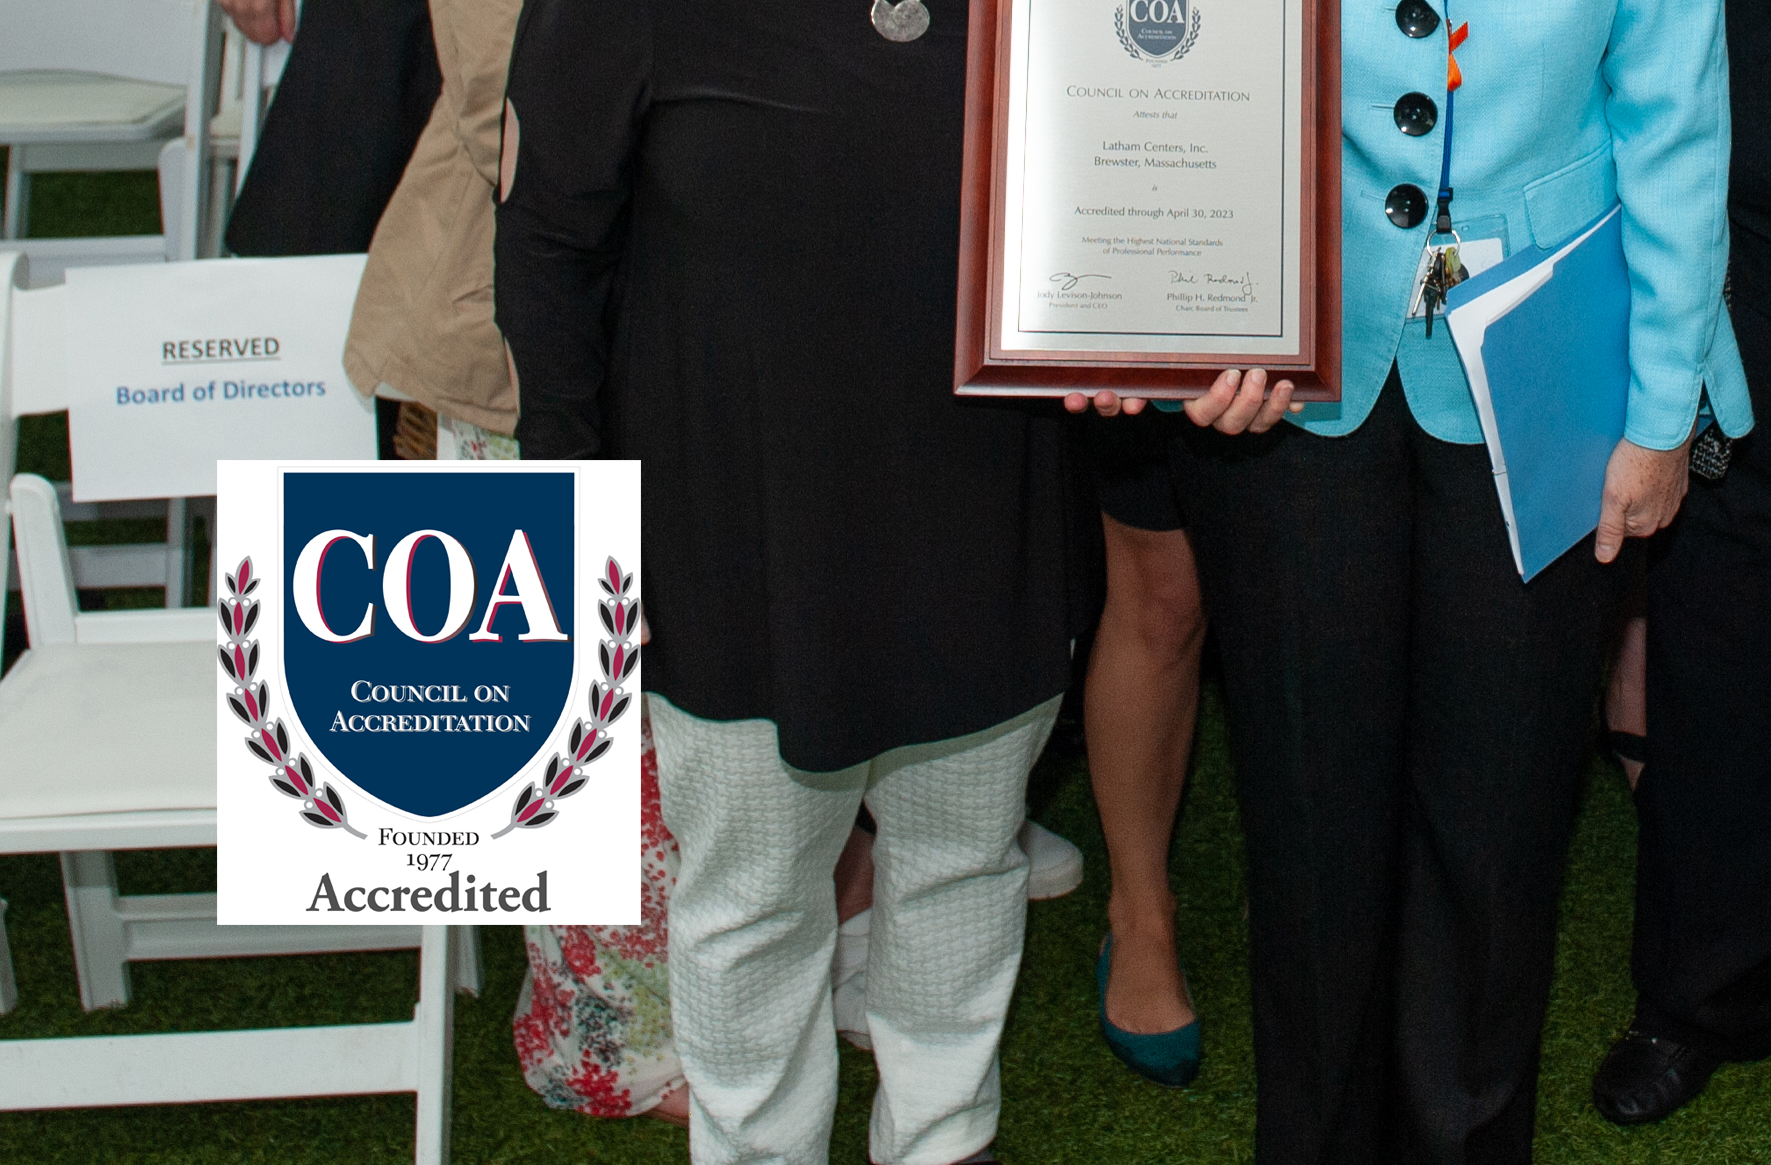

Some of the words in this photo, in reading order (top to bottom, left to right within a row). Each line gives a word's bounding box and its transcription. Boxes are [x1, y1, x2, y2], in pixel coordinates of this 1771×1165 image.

[1066, 85, 1124, 98] COUNCIL
[1129, 88, 1149, 99] ON
[1154, 88, 1250, 102] ACCREDITATION
[1133, 111, 1160, 119] Attests
[1162, 111, 1177, 119] that
[1102, 141, 1140, 151] Latham
[1144, 142, 1186, 154] Centers,
[1190, 143, 1208, 153] Inc.
[1094, 156, 1141, 168] Brewster,
[1144, 157, 1217, 169] Massachusetts
[1074, 206, 1125, 216] Accredited
[1128, 207, 1164, 219] through
[1167, 208, 1189, 219] April
[1192, 209, 1207, 219] 30,
[1210, 209, 1234, 219] 2023
[1082, 237, 1111, 245] Meeting
[1127, 237, 1154, 246] Highest
[1156, 238, 1186, 246] National
[1188, 238, 1223, 246] Standards
[1112, 247, 1154, 255] Professional
[1157, 248, 1201, 256] Performance
[1167, 293, 1193, 303] Phillip
[1207, 294, 1246, 302] Redmond
[162, 337, 280, 360] RESERVED
[116, 383, 184, 405] Board
[193, 381, 215, 400] of
[223, 380, 326, 399] Directors
